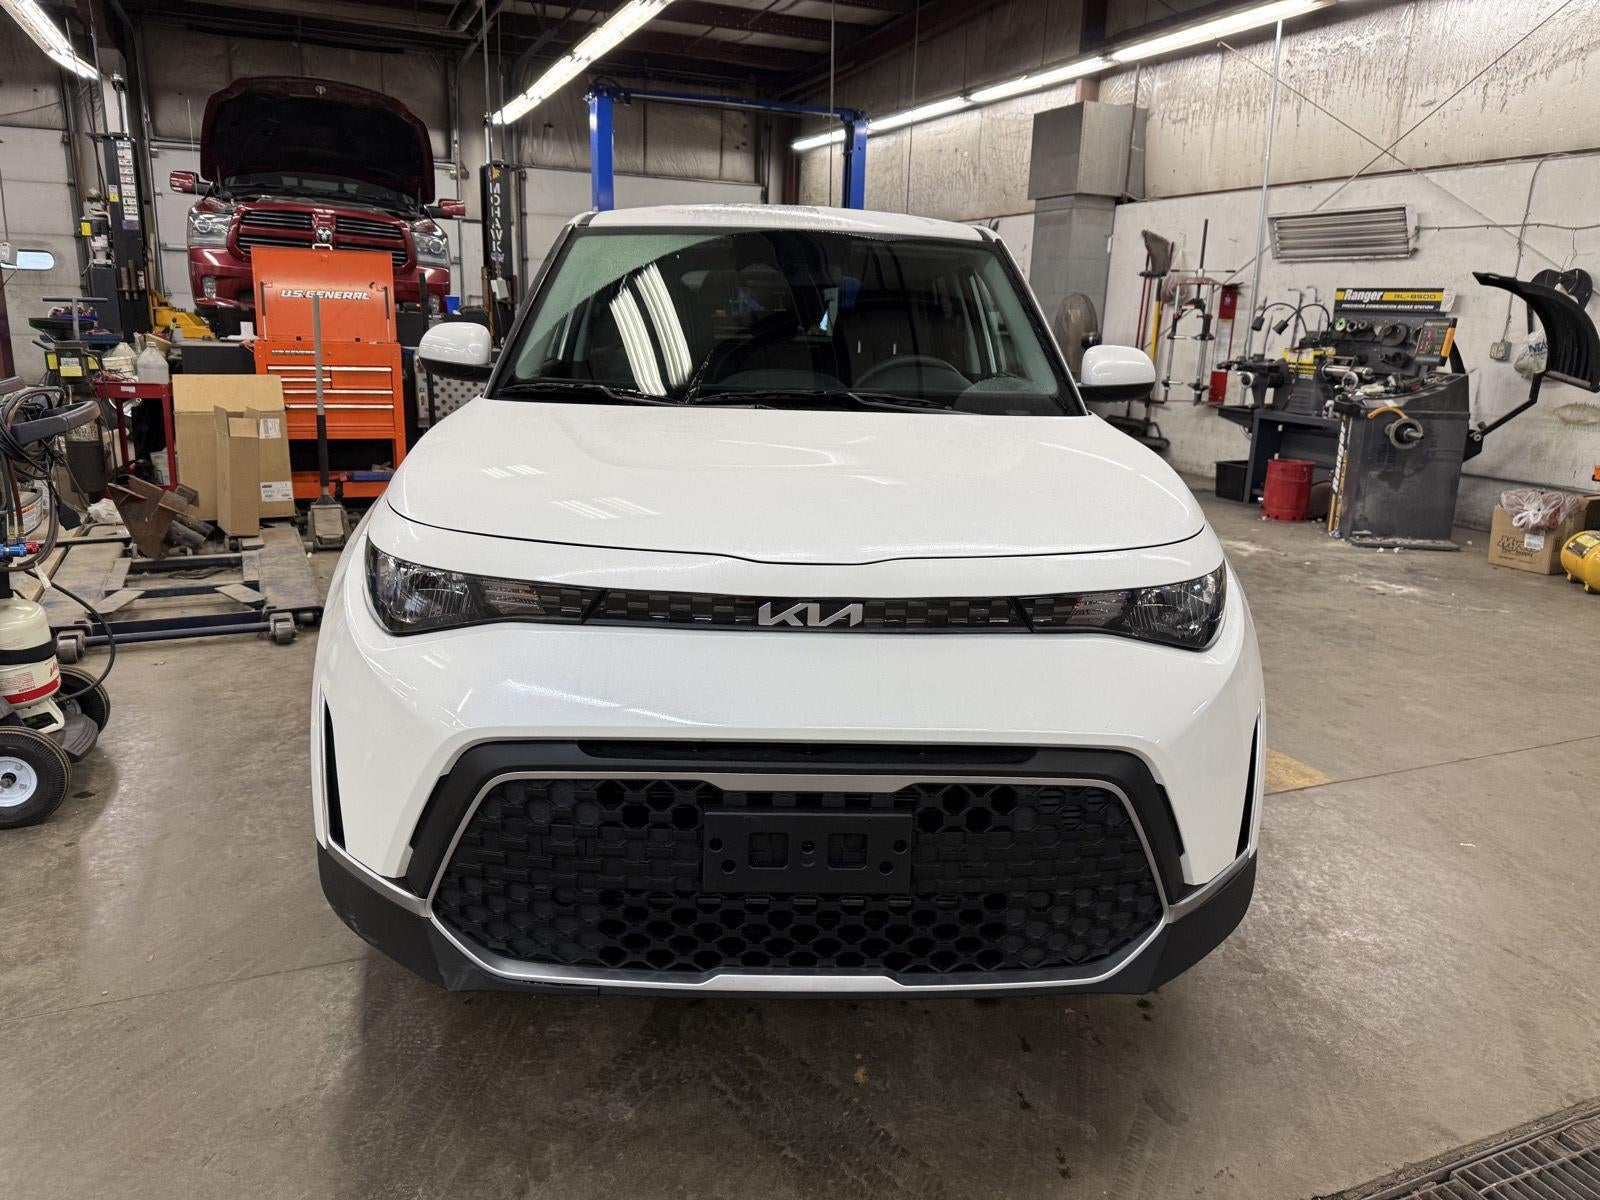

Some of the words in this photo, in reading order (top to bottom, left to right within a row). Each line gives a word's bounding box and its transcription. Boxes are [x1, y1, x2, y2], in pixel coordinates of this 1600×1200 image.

[490, 182, 504, 253] MOHAWK
[305, 289, 370, 300] GENERAL
[1343, 289, 1384, 303] Ranger
[758, 602, 863, 627] KIA
